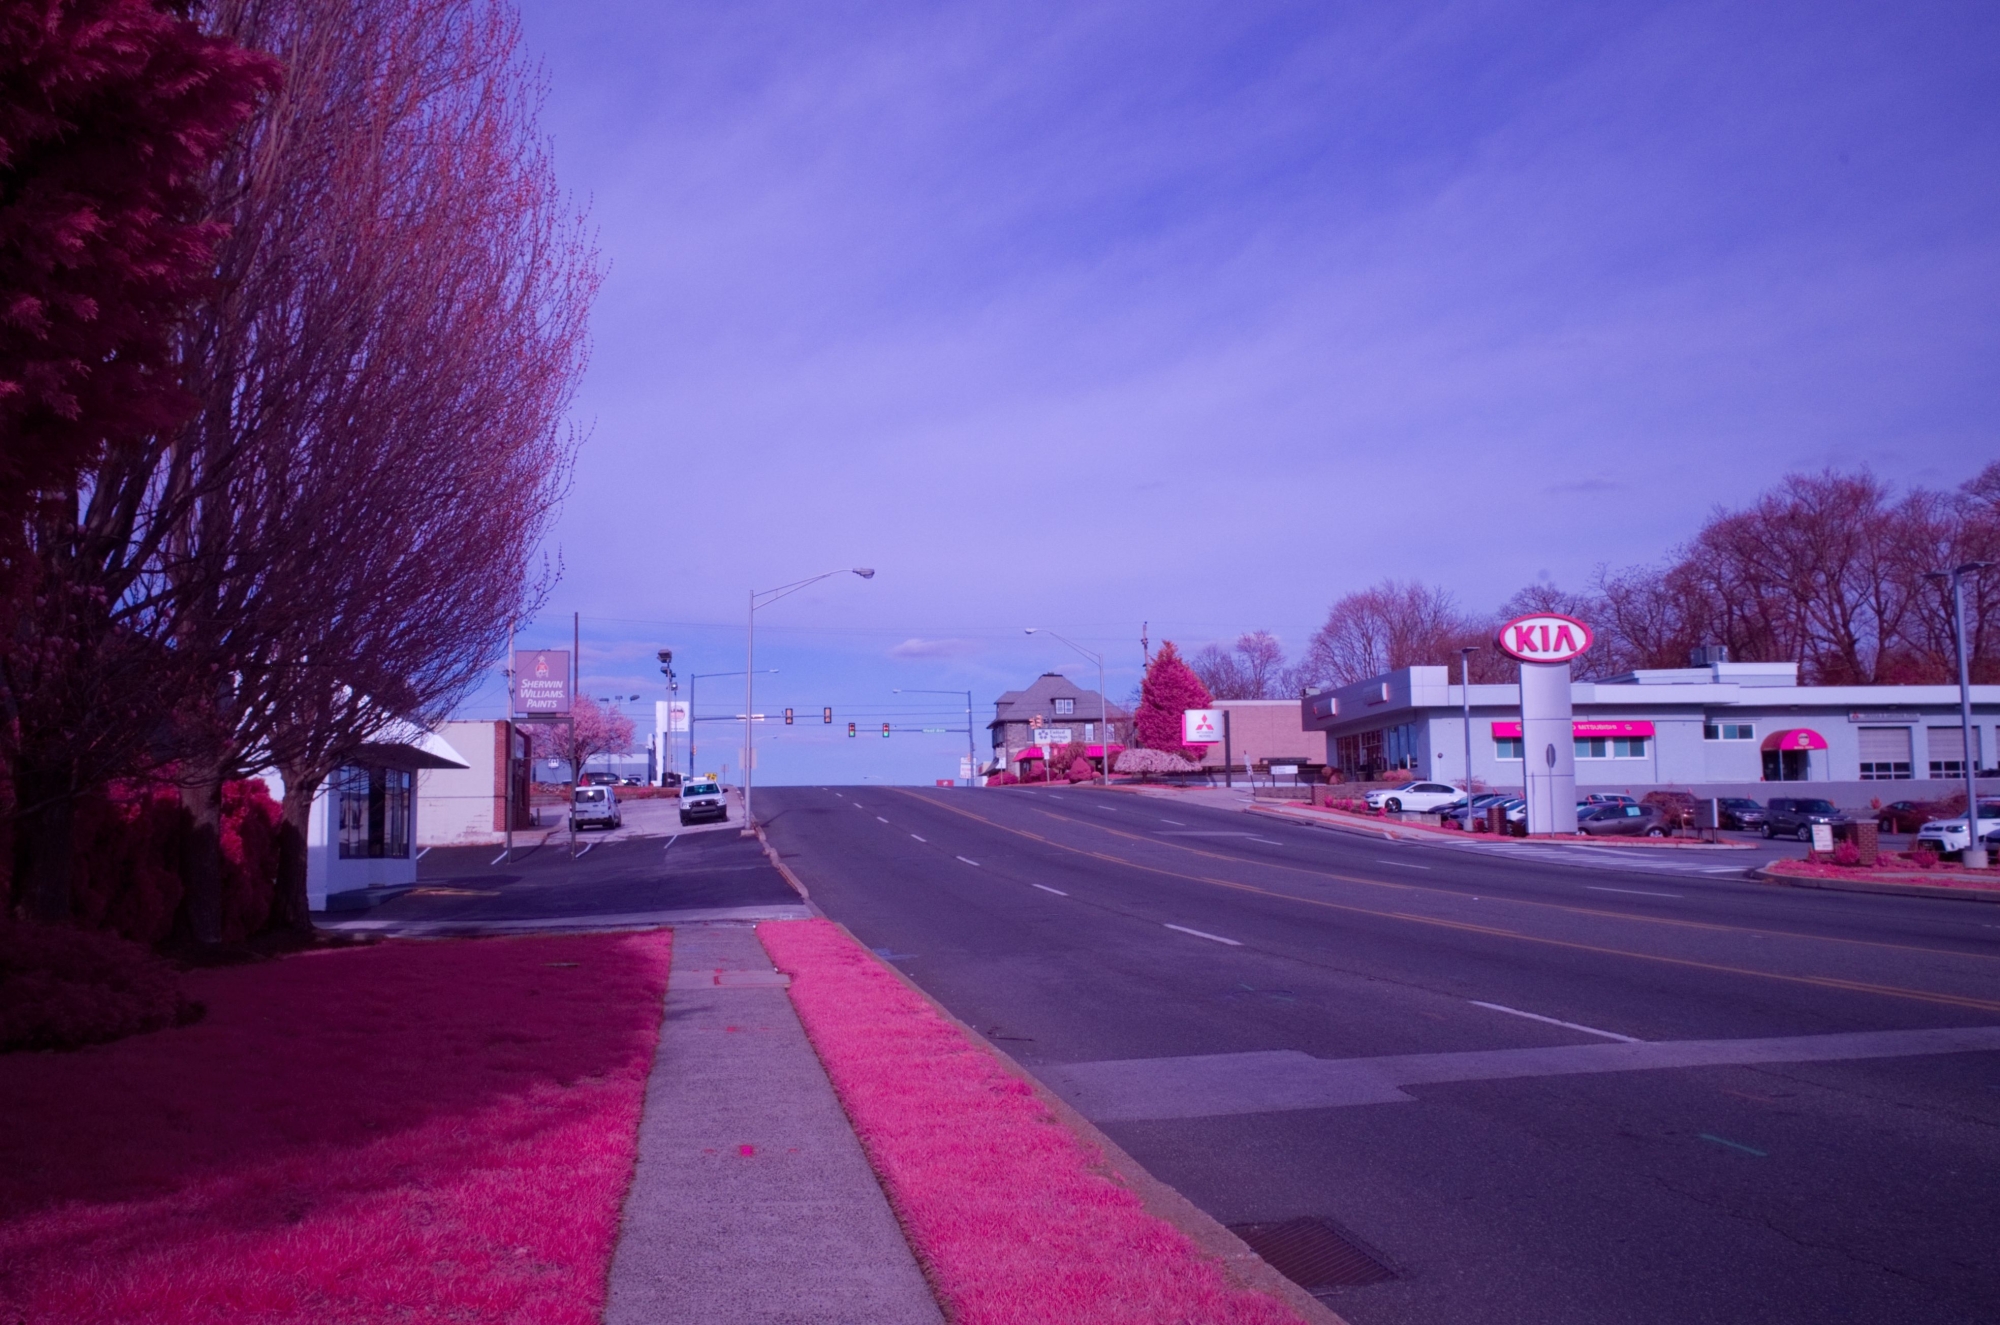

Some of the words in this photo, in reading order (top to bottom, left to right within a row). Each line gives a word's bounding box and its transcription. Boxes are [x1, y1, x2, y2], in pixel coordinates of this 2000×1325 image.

[1514, 625, 1577, 652] KIA
[521, 679, 563, 688] SHERWIN
[526, 699, 557, 708] PAINTS
